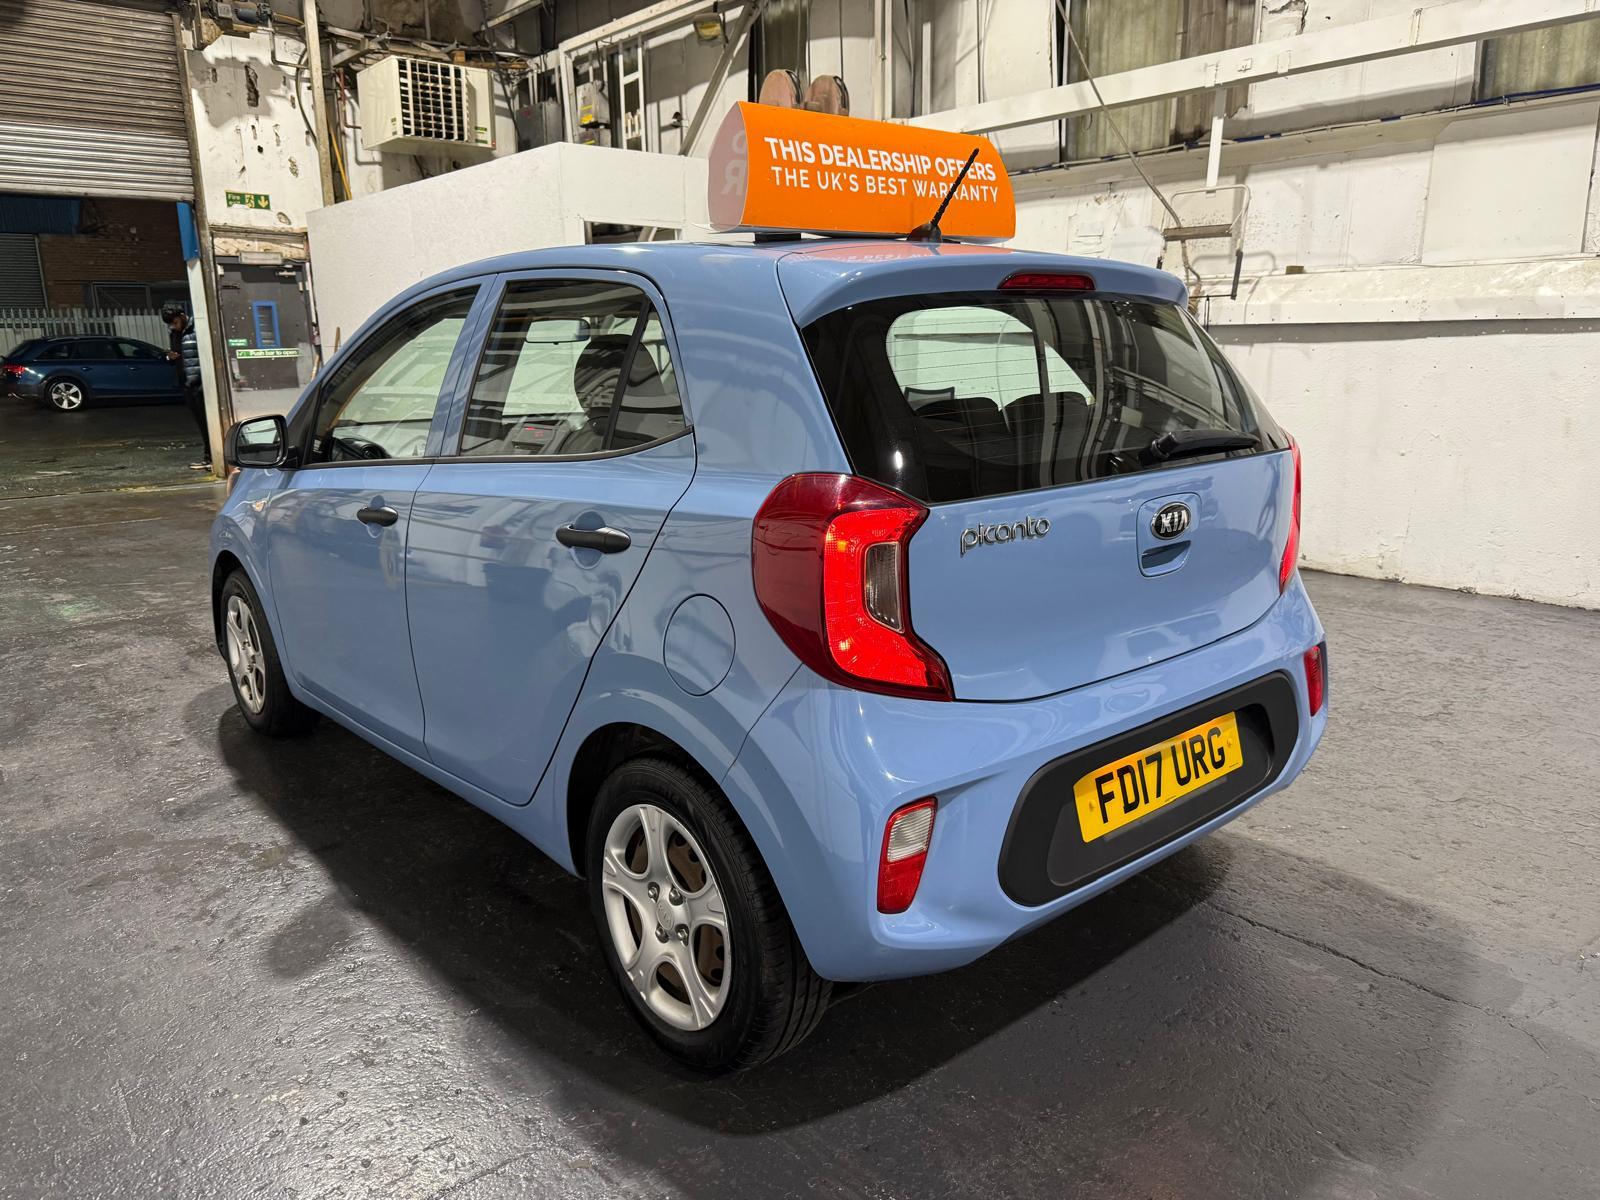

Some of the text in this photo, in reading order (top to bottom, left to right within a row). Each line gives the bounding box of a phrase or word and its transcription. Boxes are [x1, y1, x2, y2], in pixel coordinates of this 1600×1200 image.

[764, 136, 816, 164] THIS
[818, 143, 932, 175] DEALERSHIP
[934, 156, 997, 181] OFFERS
[770, 166, 811, 188] THE
[816, 170, 860, 193] UK'S
[865, 175, 908, 196] BEST
[960, 513, 1050, 557] picanto
[1160, 509, 1188, 533] KIA
[1095, 726, 1226, 824] FD17 URG
